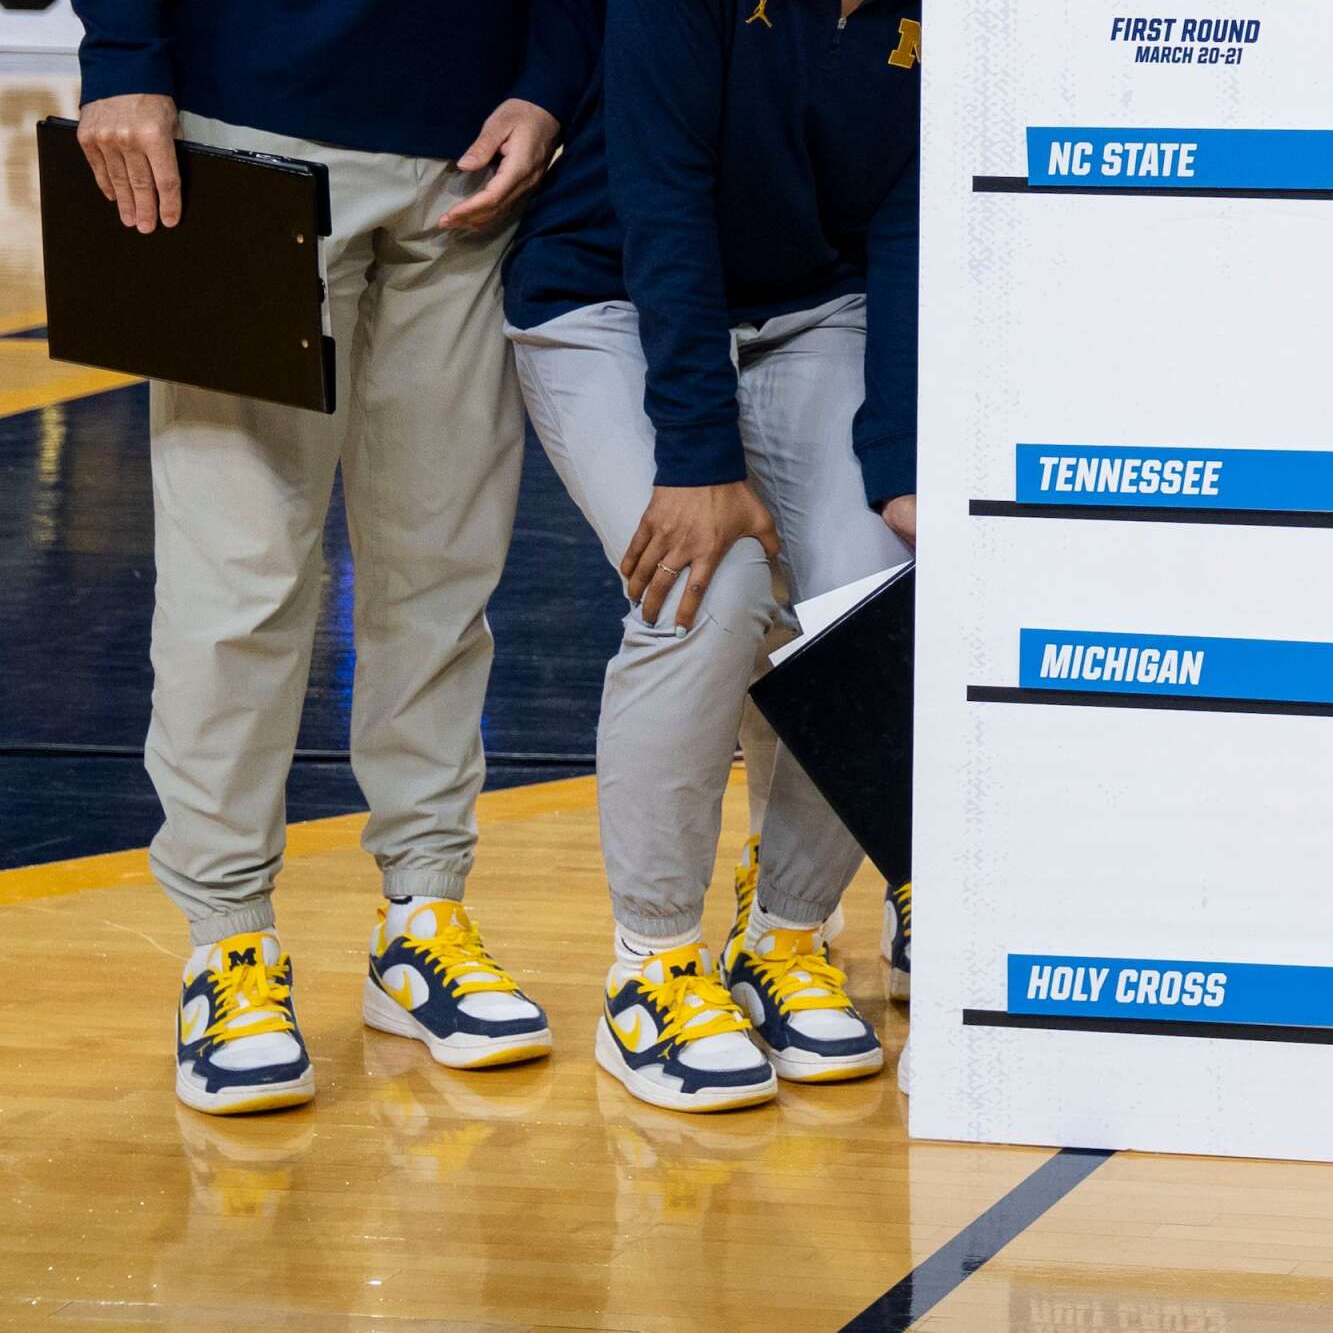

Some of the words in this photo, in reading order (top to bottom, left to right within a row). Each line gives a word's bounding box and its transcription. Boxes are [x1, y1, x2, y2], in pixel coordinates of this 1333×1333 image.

[1110, 17, 1176, 42] FIRST
[1181, 18, 1261, 44] ROUND
[1135, 45, 1194, 64] MARCH
[1197, 47, 1243, 65] 20-21
[1047, 141, 1093, 176] NC
[1101, 142, 1198, 178] STATE
[1039, 456, 1223, 496] TENNESSEE
[1040, 644, 1204, 686] MICHIGAN
[228, 947, 257, 971] M
[1027, 962, 1109, 1002] HOLY
[1115, 969, 1227, 1008] CROSS
